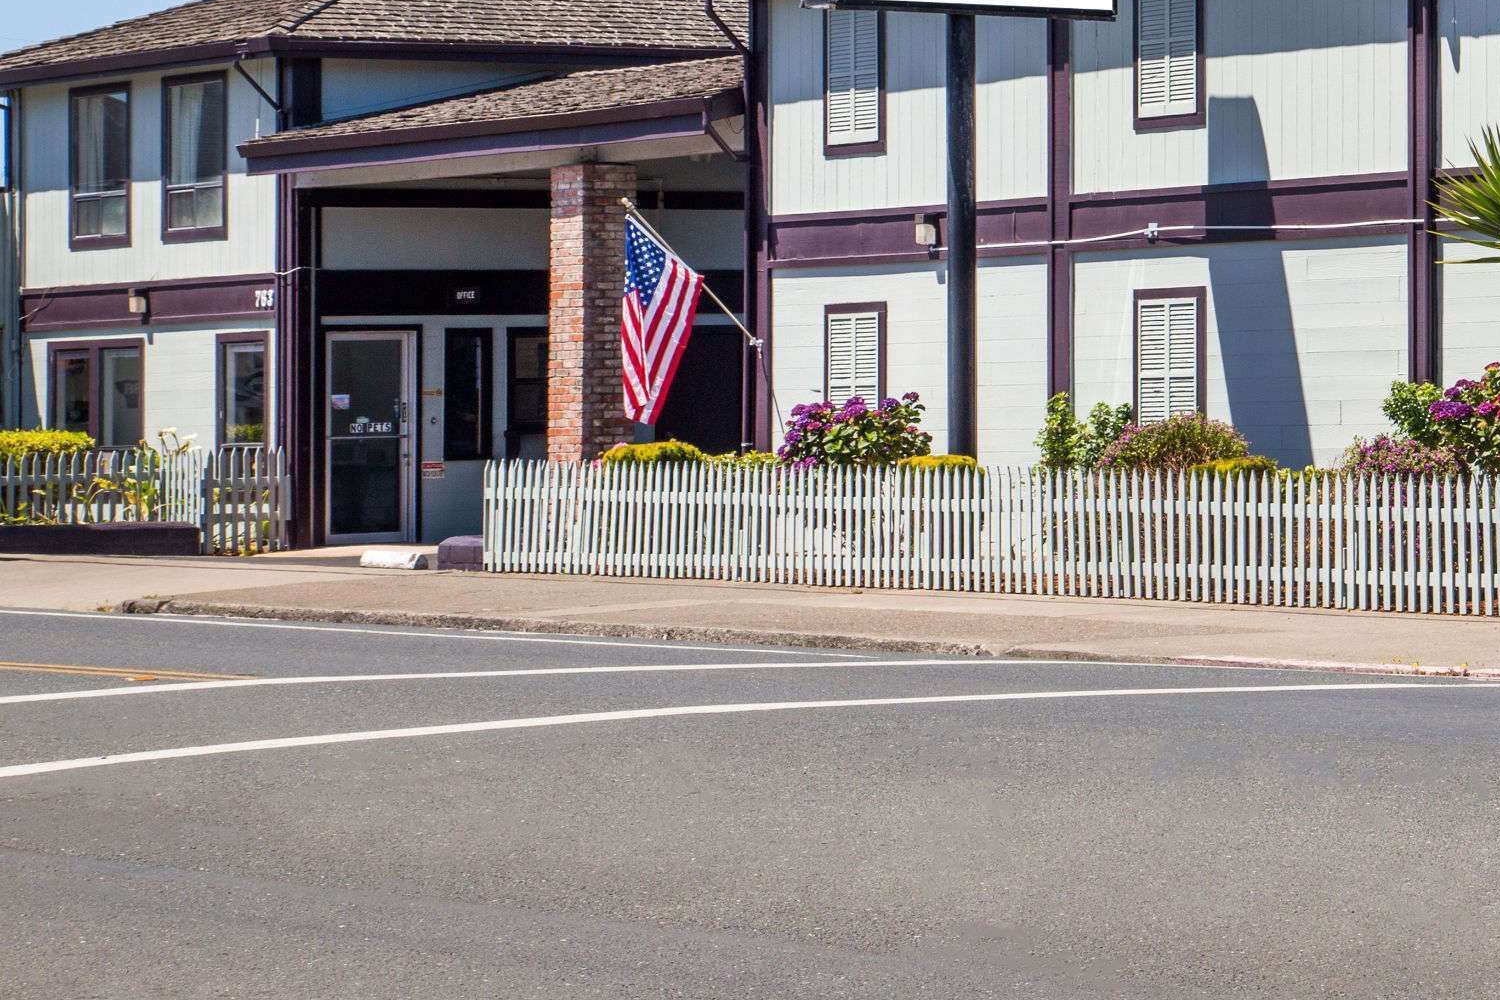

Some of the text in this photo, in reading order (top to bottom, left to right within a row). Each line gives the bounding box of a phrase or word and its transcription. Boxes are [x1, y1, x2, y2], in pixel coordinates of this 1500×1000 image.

[456, 290, 475, 300] OFFICE
[350, 422, 392, 433] NO PETS
